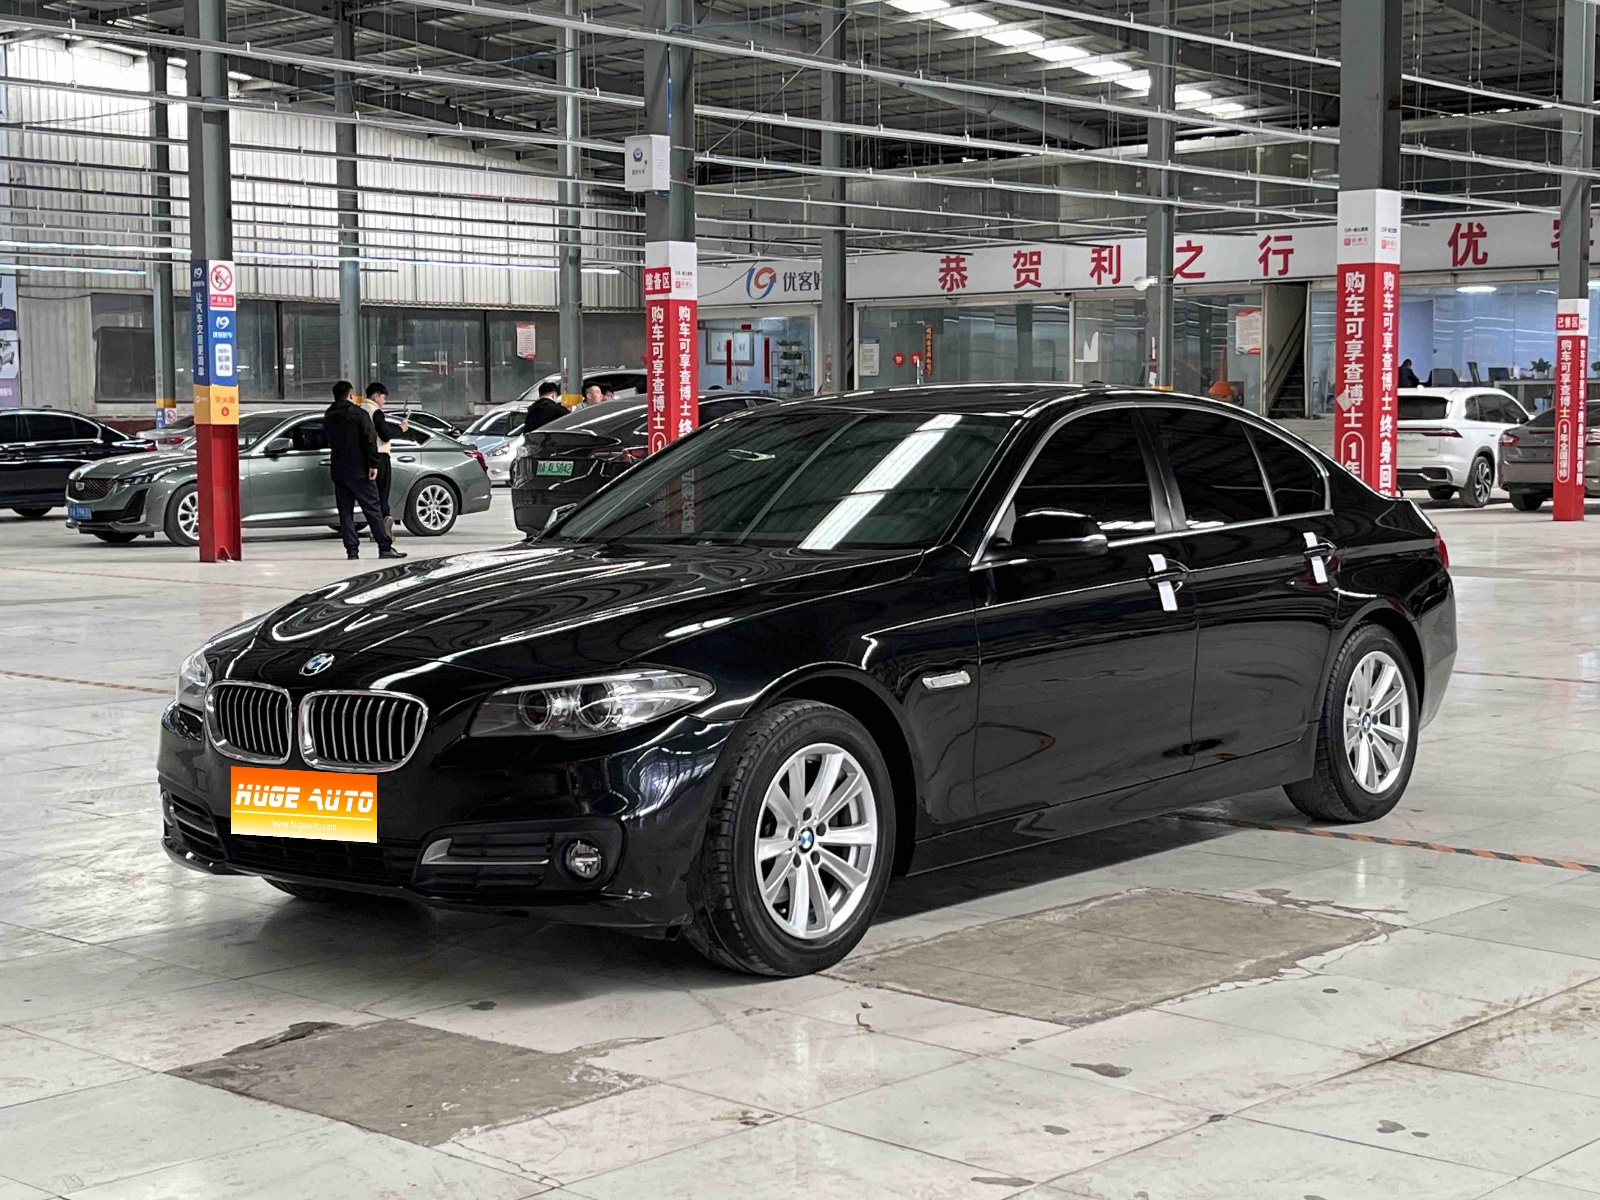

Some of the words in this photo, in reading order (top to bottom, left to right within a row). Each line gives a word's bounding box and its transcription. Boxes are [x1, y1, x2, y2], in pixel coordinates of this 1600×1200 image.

[645, 272, 671, 290] 整备区
[938, 235, 1294, 293] 恭贺利之行
[651, 306, 665, 430] 购车可享查博士
[678, 305, 692, 416] 购车可享查博士
[1381, 271, 1395, 411] 购车可享查博士
[1560, 339, 1572, 418] 购车可享查博士
[1379, 414, 1393, 496] 终身回
